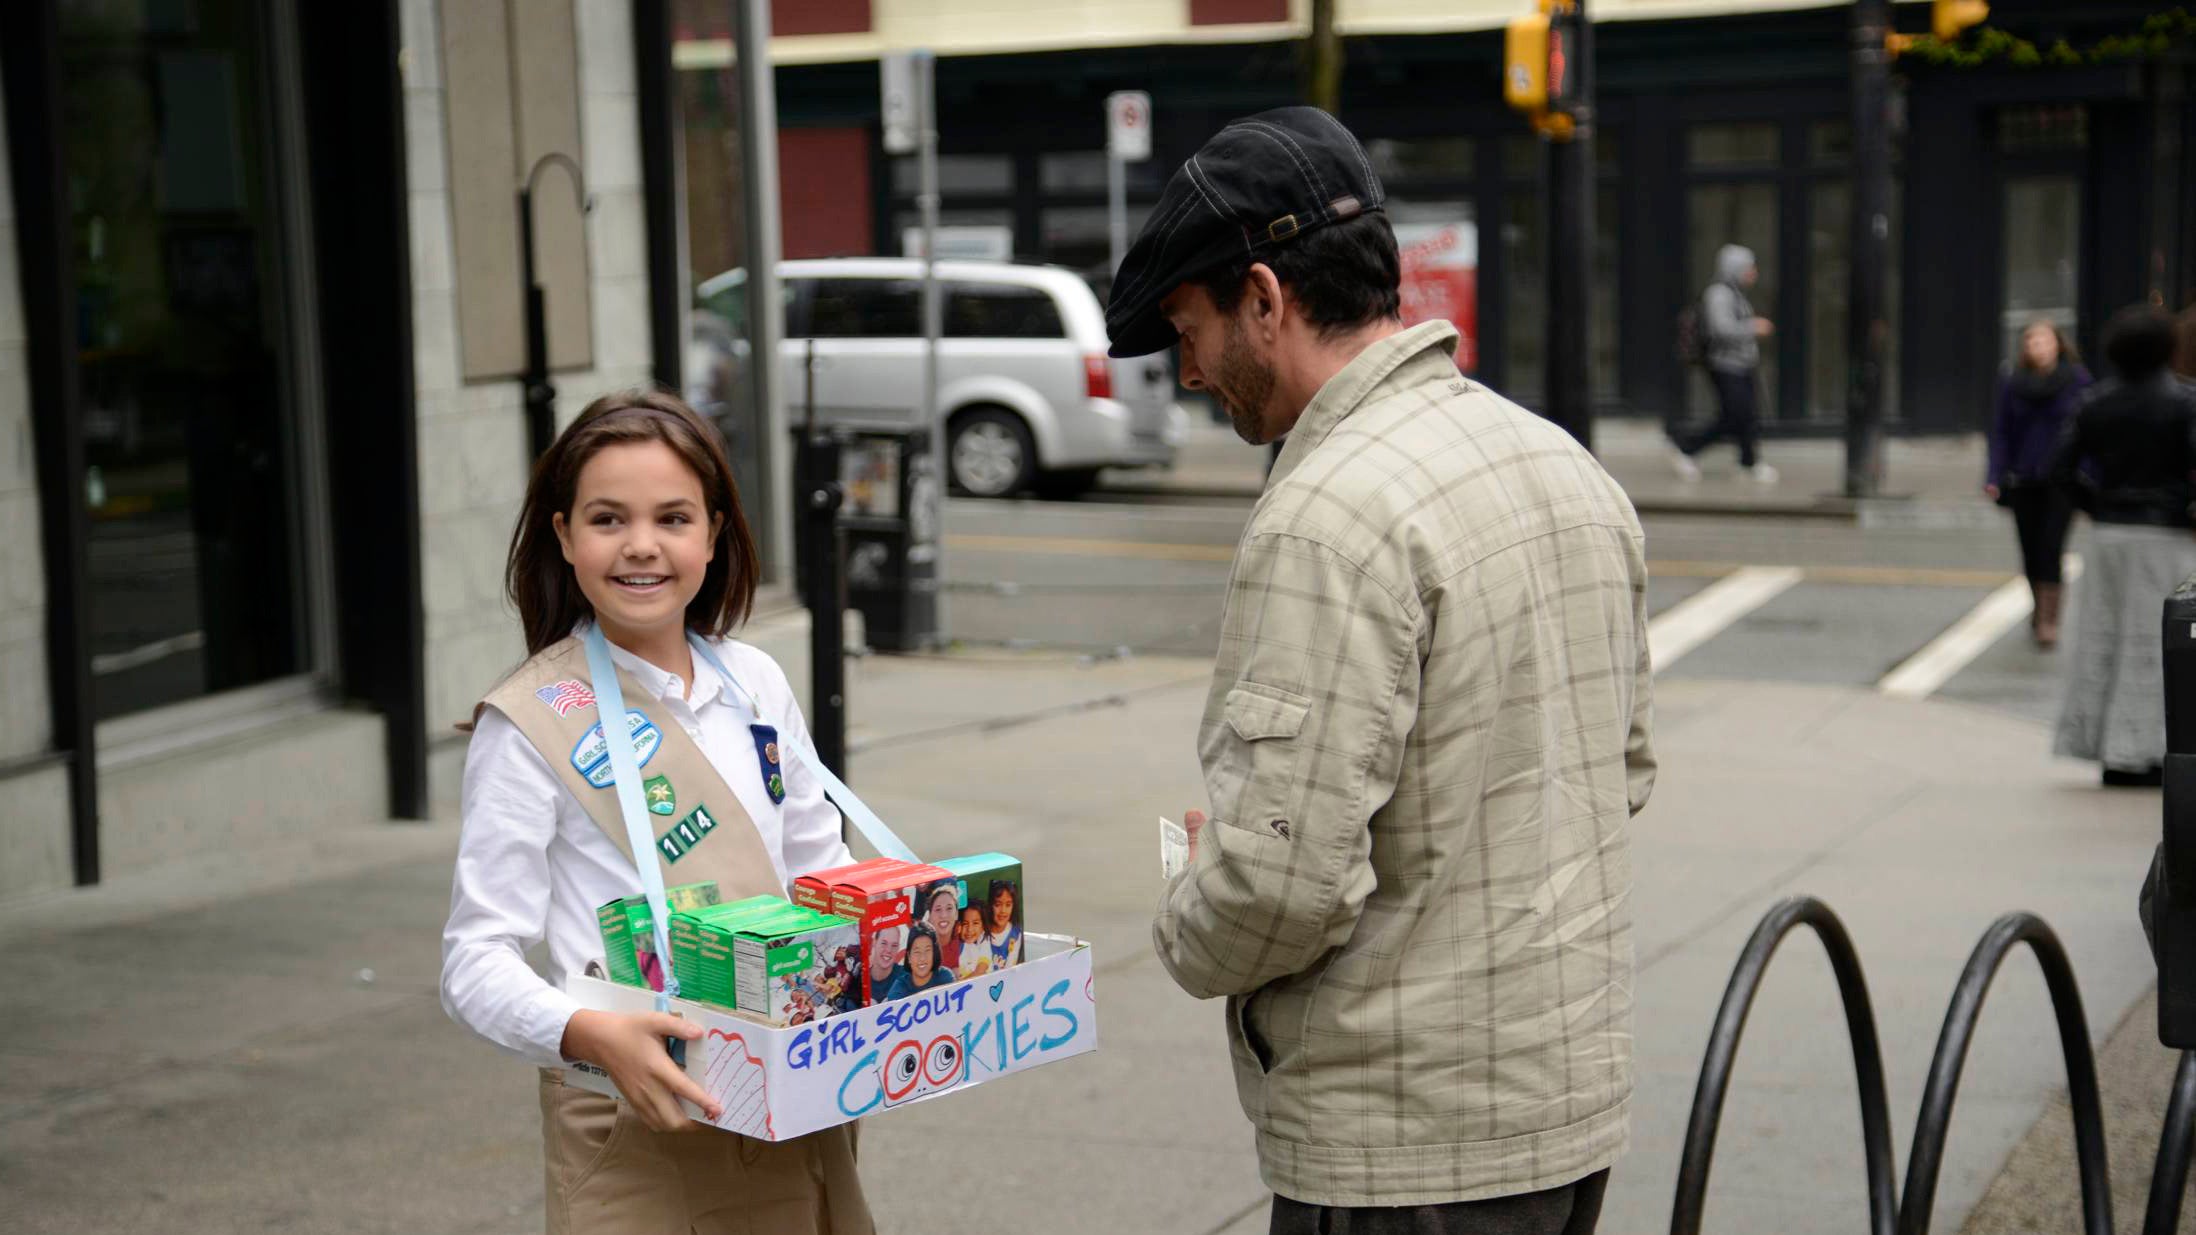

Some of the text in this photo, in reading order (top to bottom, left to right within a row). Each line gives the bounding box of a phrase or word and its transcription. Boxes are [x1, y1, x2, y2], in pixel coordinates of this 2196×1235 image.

[578, 750, 597, 765] GIRL
[663, 809, 712, 856] 114
[874, 983, 973, 1044] SCOUT
[837, 979, 1078, 1117] COOKIES
